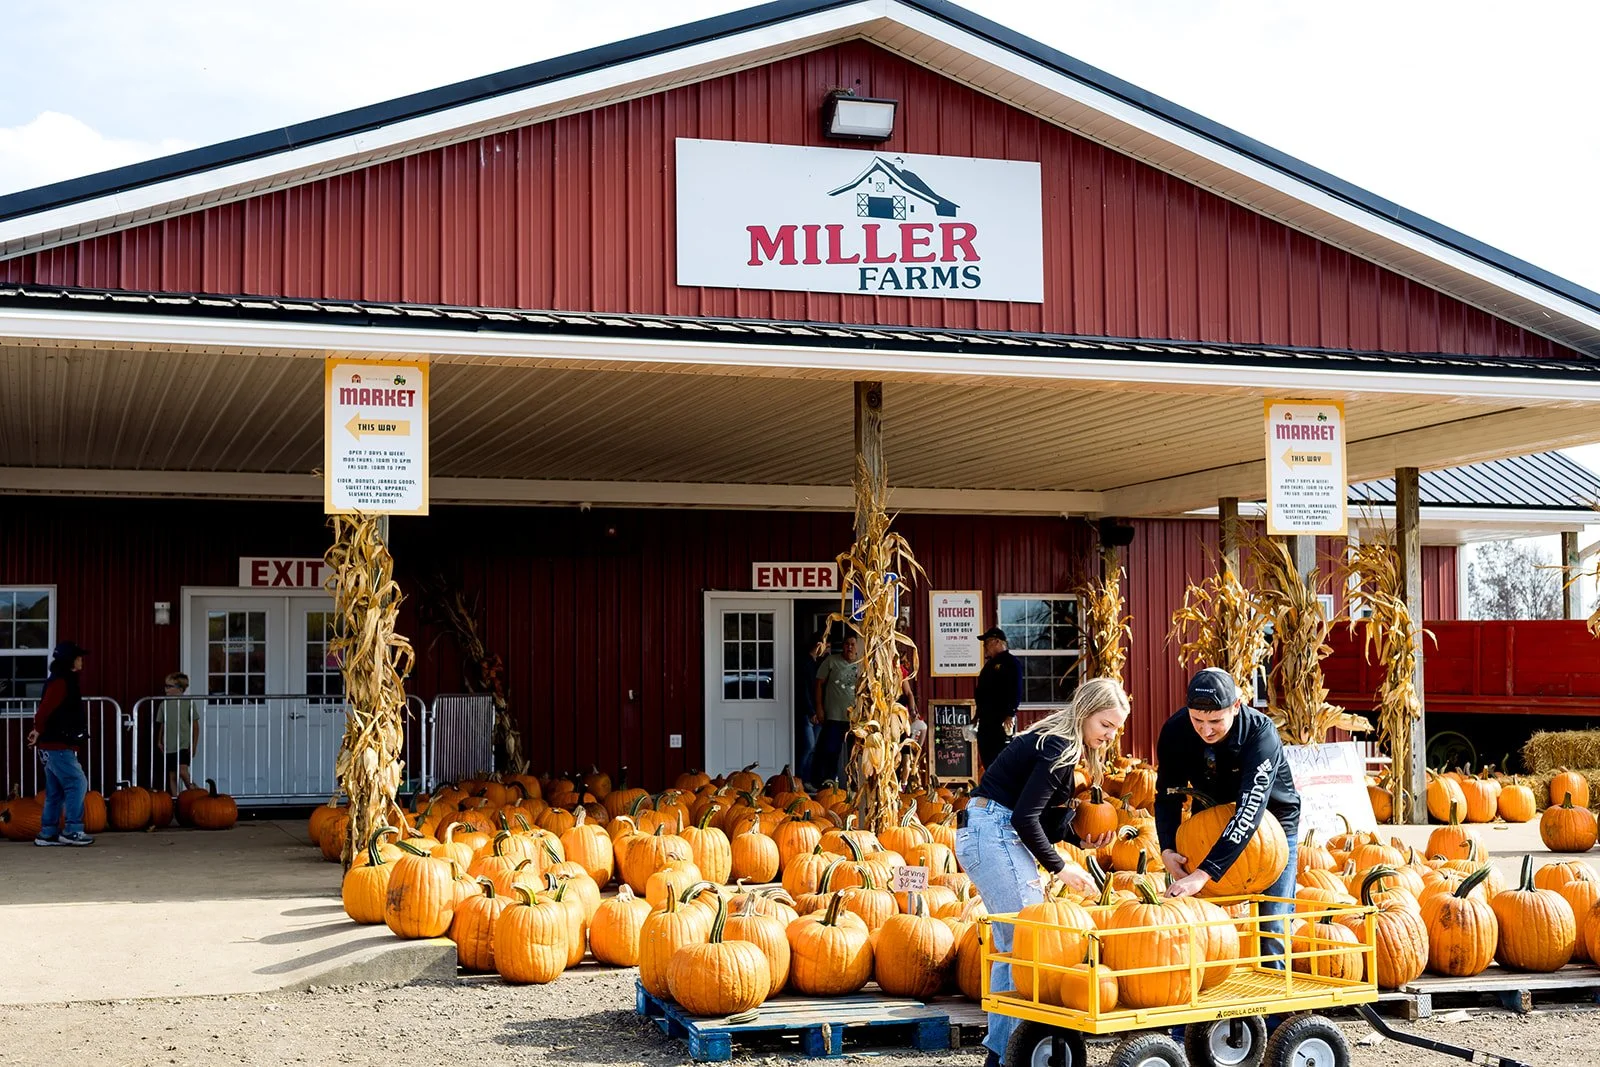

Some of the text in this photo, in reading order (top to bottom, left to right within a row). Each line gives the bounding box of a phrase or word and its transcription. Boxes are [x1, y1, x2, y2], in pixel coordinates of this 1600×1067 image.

[746, 223, 980, 266] MILLER
[858, 266, 982, 290] FARMS
[340, 388, 415, 407] MARKET
[1276, 424, 1335, 440] MARKET
[252, 560, 324, 586] EXIT
[758, 567, 832, 587] ENTER
[938, 608, 974, 617] KITCHEN
[935, 706, 970, 725] Kitchen
[899, 866, 925, 884] Carving
